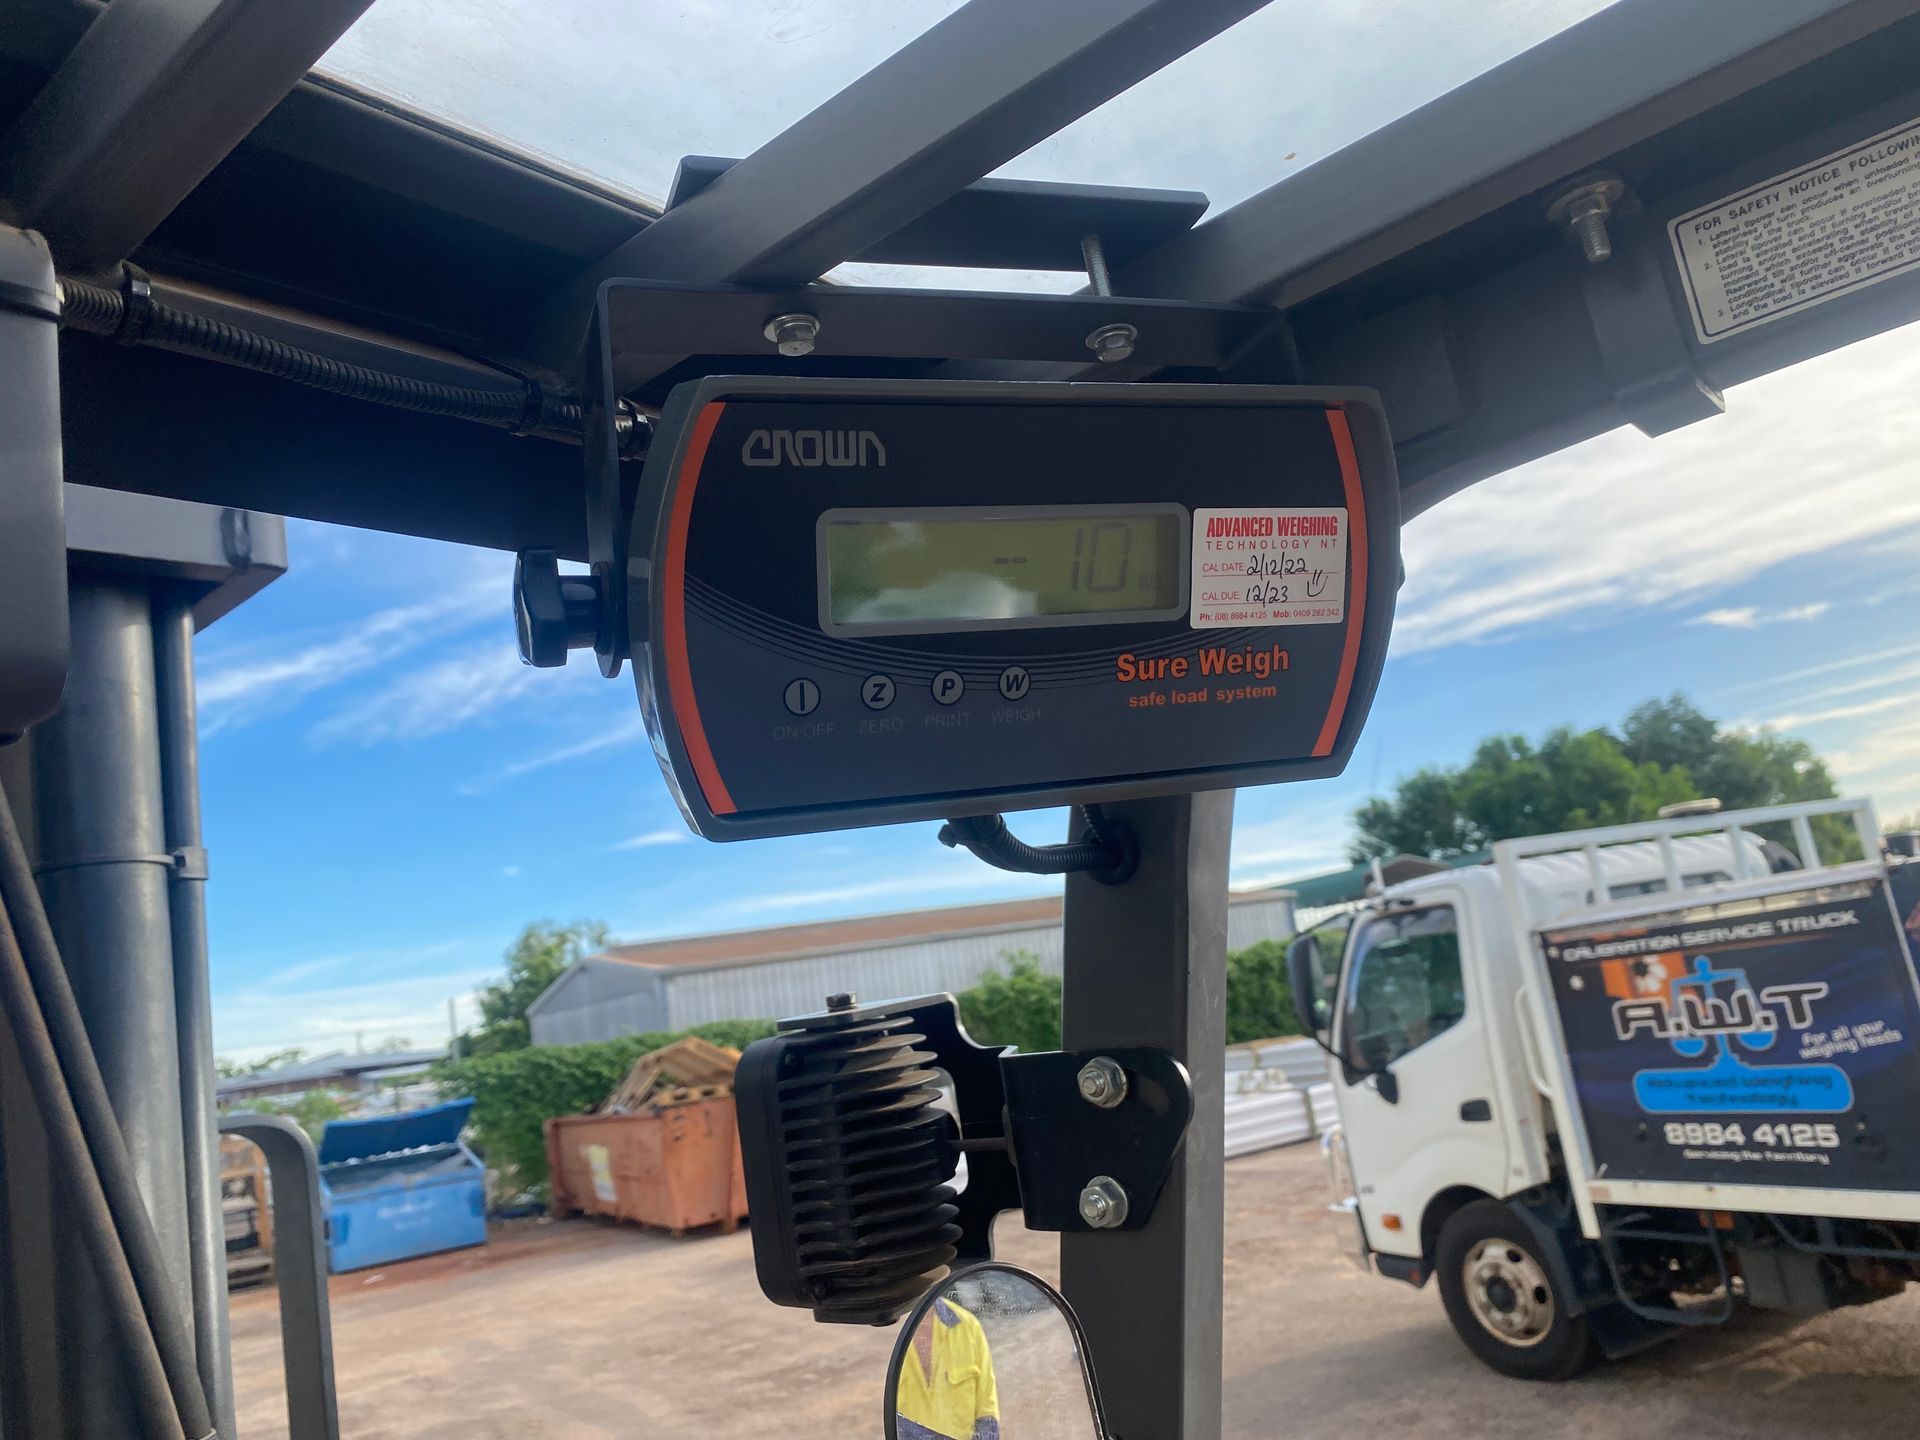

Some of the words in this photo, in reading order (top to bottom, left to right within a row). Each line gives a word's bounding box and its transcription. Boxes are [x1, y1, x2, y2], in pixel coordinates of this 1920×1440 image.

[1694, 216, 1721, 234] FOR
[1728, 192, 1779, 219] SAFETY
[1789, 167, 1840, 195] NOTICE
[1709, 224, 1739, 241] Lateral
[1744, 211, 1774, 227] tipover
[1780, 203, 1796, 213] can
[1802, 190, 1827, 204] occur
[1833, 178, 1858, 191] when
[1864, 156, 1909, 179] unloaded
[1777, 212, 1795, 223] turn
[1801, 193, 1843, 214] produces
[1716, 248, 1746, 264] Lateral
[1751, 235, 1781, 251] tipover
[1788, 227, 1803, 236] can
[1809, 214, 1835, 228] occur
[1852, 185, 1905, 211] overloaded
[1719, 260, 1737, 272] load
[1755, 238, 1792, 258] elevated
[1798, 230, 1815, 241] and
[1831, 211, 1866, 228] turning
[1871, 197, 1901, 213] and/or
[1715, 240, 1748, 256] stability
[1721, 264, 1753, 280] turning
[1758, 251, 1785, 266] and/or
[1792, 227, 1848, 253] accelerating
[1853, 216, 1879, 229] when
[1723, 270, 1759, 288] moment
[1764, 258, 1791, 272] which
[1796, 242, 1834, 260] exceeds
[1839, 234, 1854, 243] the
[1860, 217, 1897, 235] stability
[1725, 275, 1767, 296] Rearward
[1790, 257, 1818, 271] and/or
[1824, 237, 1868, 258] off-center
[1728, 282, 1774, 303] conditions
[1780, 273, 1795, 283] will
[1800, 261, 1831, 276] further
[1837, 242, 1883, 263] aggravate
[1889, 234, 1904, 242] the
[1730, 286, 1785, 311] Longitudinal
[1790, 274, 1821, 288] tipover
[1828, 265, 1844, 275] can
[1850, 252, 1877, 266] occur
[1733, 308, 1749, 319] and
[1773, 292, 1792, 304] load
[1811, 271, 1849, 290] elevated
[1866, 251, 1903, 269] forward
[742, 429, 886, 467] CROWN
[1206, 517, 1274, 538] ADVANCED
[1277, 516, 1338, 537] WEIGHING
[1206, 539, 1310, 551] TECHNOLOGY
[1320, 538, 1338, 548] NT
[1202, 562, 1219, 572] CAL
[1246, 551, 1309, 581] 2/12/22
[1201, 592, 1219, 601] CAL
[1245, 580, 1289, 609] 12/23
[1200, 613, 1213, 621] Ph:
[1249, 611, 1268, 620] 4125
[1273, 610, 1292, 619] Mob:
[1293, 609, 1312, 618] 0409
[1115, 651, 1189, 682] Sure
[1198, 643, 1290, 680] Weigh
[1128, 692, 1166, 708] safe
[1171, 689, 1208, 705] load
[1216, 684, 1277, 704] system
[858, 717, 904, 735] ZERO
[924, 712, 970, 729] PRINT
[991, 708, 1041, 724] WEIGH
[1680, 920, 1774, 946] SERVICE
[1775, 909, 1860, 934] TRUCK
[1663, 1122, 1746, 1147] 8984
[1752, 1123, 1840, 1148] 4125
